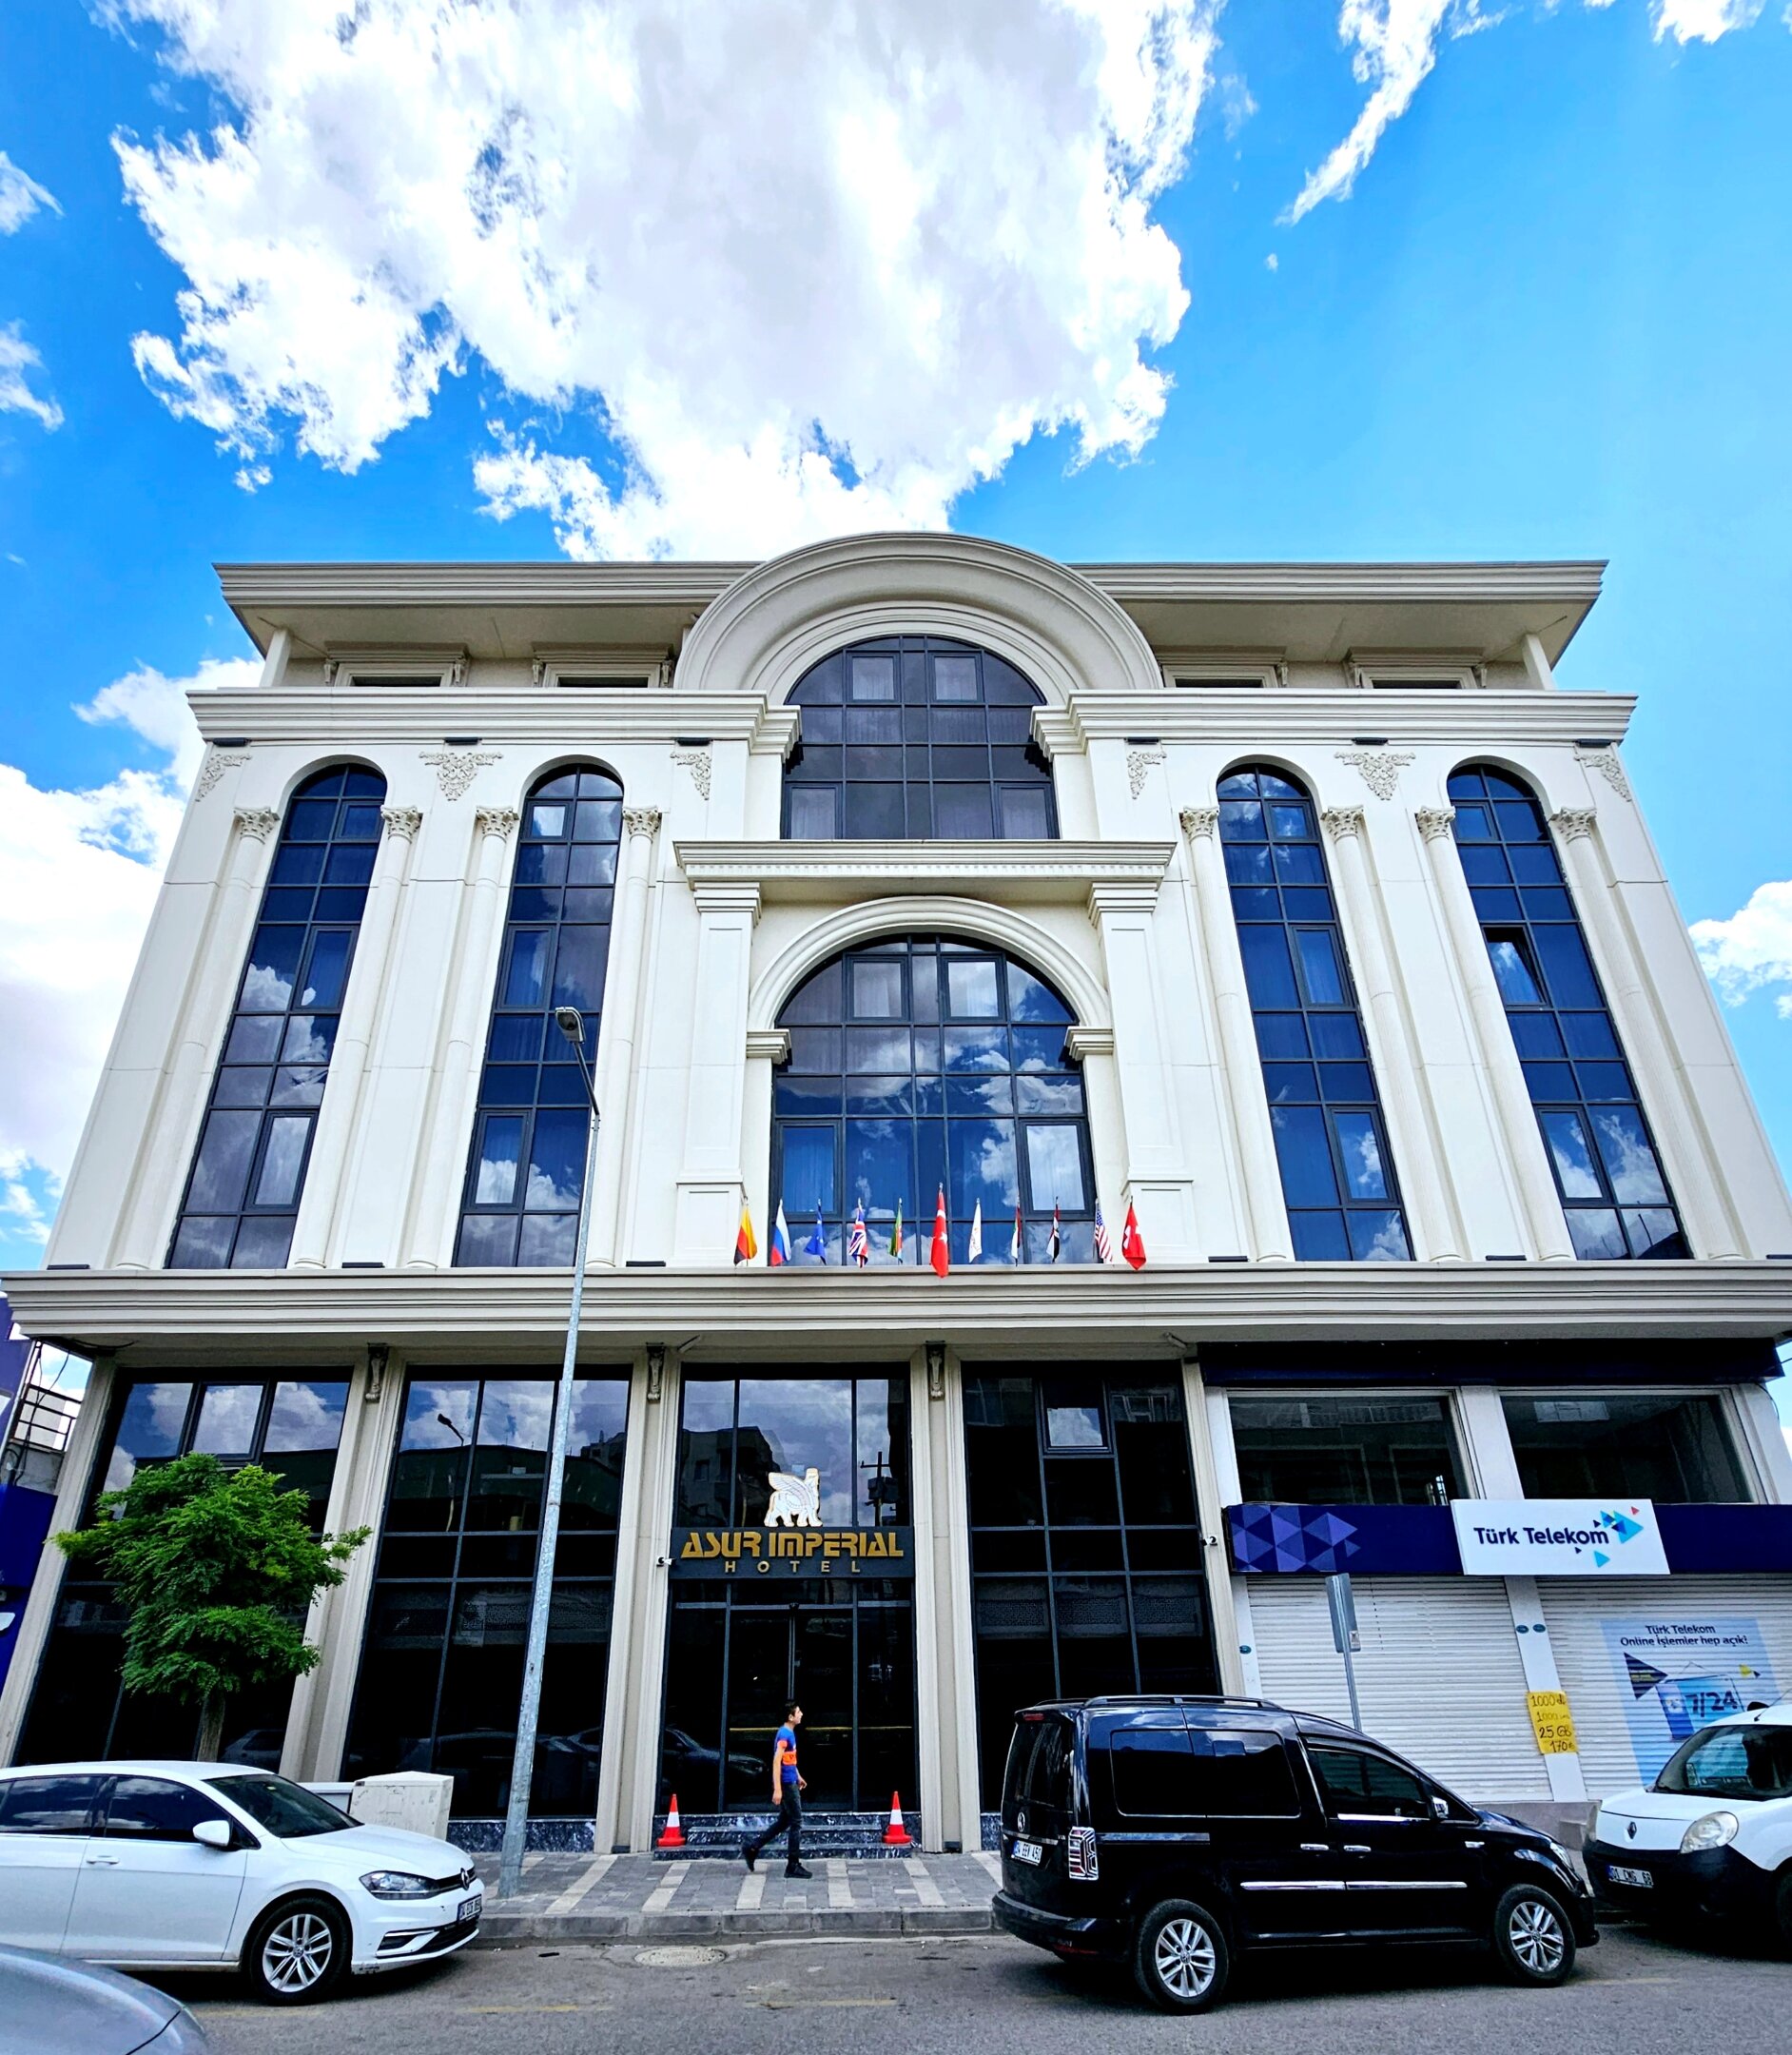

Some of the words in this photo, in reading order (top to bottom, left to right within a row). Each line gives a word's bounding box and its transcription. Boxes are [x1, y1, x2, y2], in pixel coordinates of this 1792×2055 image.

[1473, 1527, 1520, 1545] Türk
[1523, 1527, 1609, 1545] Telekom
[680, 1531, 762, 1559] ASUR
[769, 1532, 905, 1558] IMPERIAL
[724, 1560, 861, 1574] HOTEL
[1645, 1625, 1670, 1635] Türk
[1672, 1624, 1716, 1634] Telekom
[1620, 1636, 1655, 1647] Online
[1700, 1635, 1720, 1647] hep
[1530, 1694, 1556, 1708] 1000
[1539, 1725, 1555, 1739] 25
